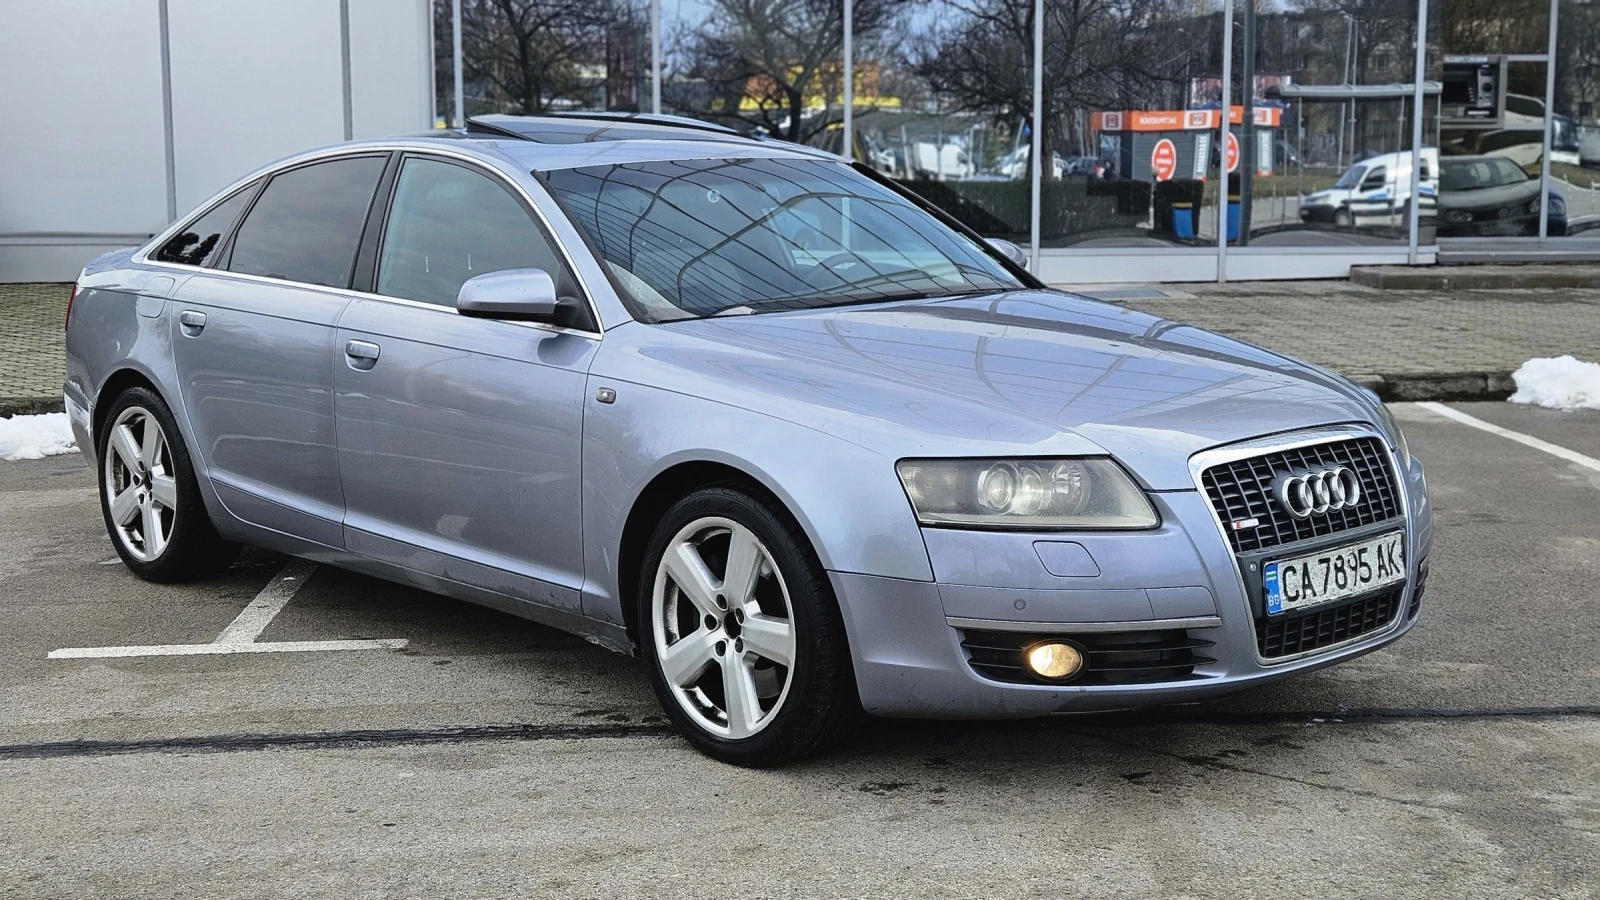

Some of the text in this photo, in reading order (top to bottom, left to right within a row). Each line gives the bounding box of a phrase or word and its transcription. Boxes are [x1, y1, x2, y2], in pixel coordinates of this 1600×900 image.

[1282, 540, 1401, 602] CA 7895 AK
[1267, 593, 1280, 607] BG
